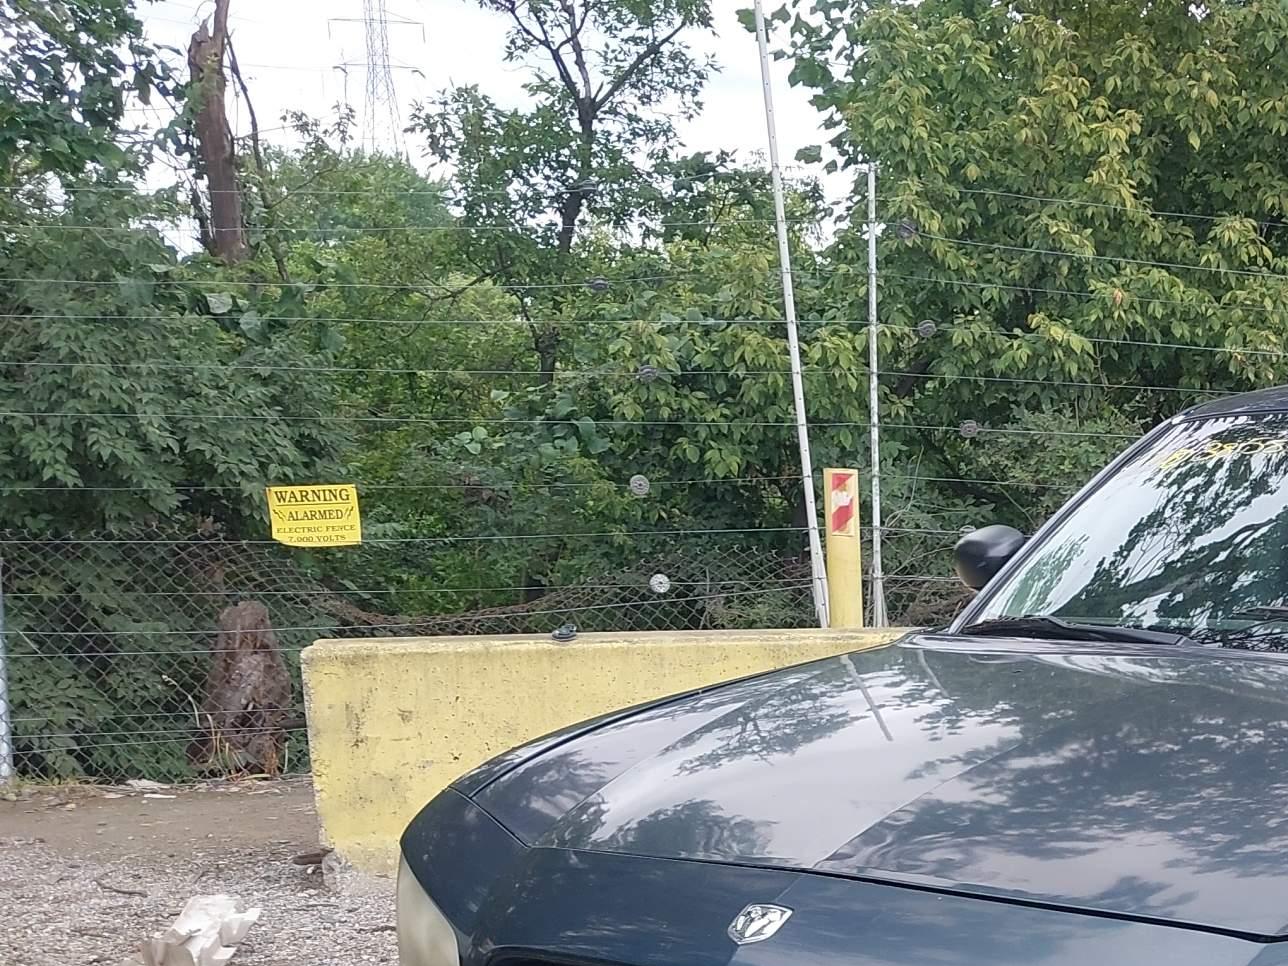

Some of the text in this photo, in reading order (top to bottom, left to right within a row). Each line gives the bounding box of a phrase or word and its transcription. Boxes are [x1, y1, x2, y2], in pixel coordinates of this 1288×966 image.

[274, 488, 350, 503] WARNING
[287, 508, 344, 521] ALARMED
[276, 524, 356, 534] ELECTRIC FENCE
[317, 534, 346, 543] VOLTS
